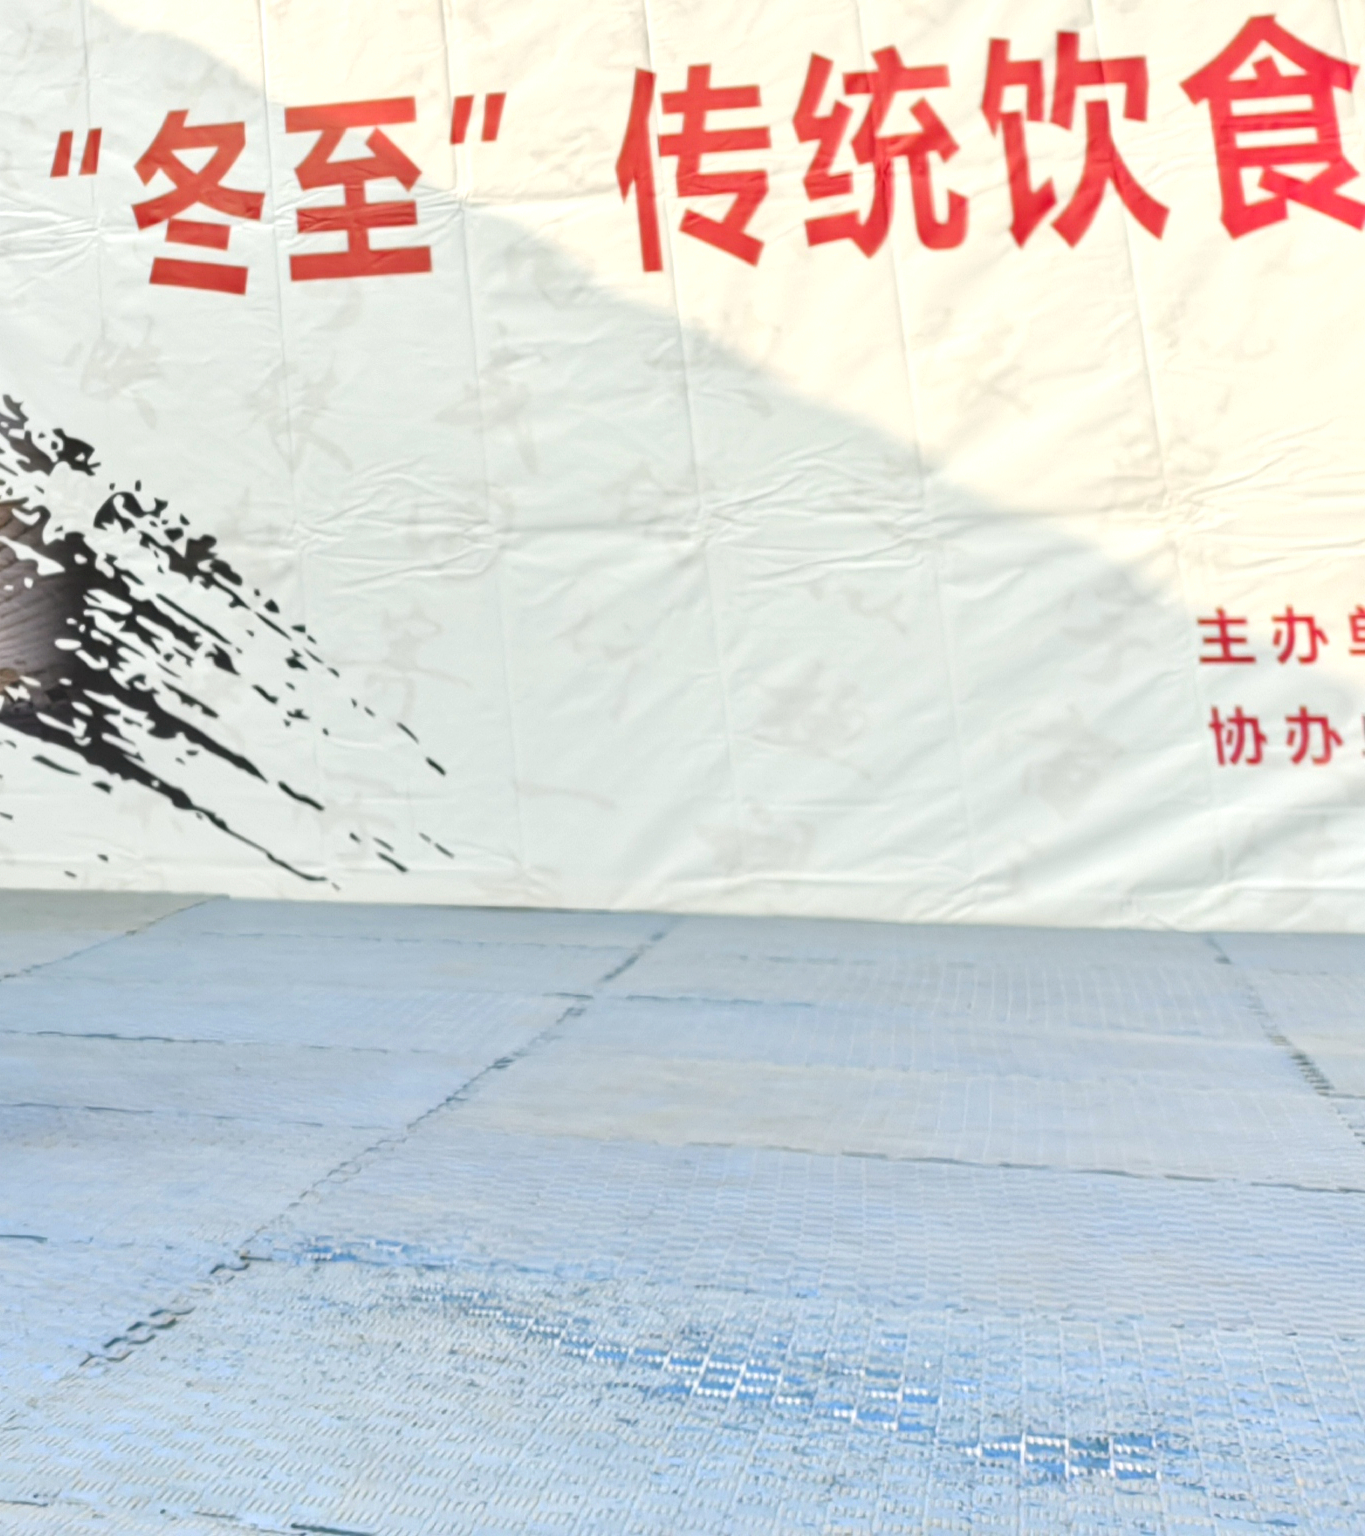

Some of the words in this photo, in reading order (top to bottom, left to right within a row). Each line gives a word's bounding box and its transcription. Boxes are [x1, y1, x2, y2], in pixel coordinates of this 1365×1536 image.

[615, 13, 1365, 273] 传统饮食
[1208, 705, 1365, 767] 协办
